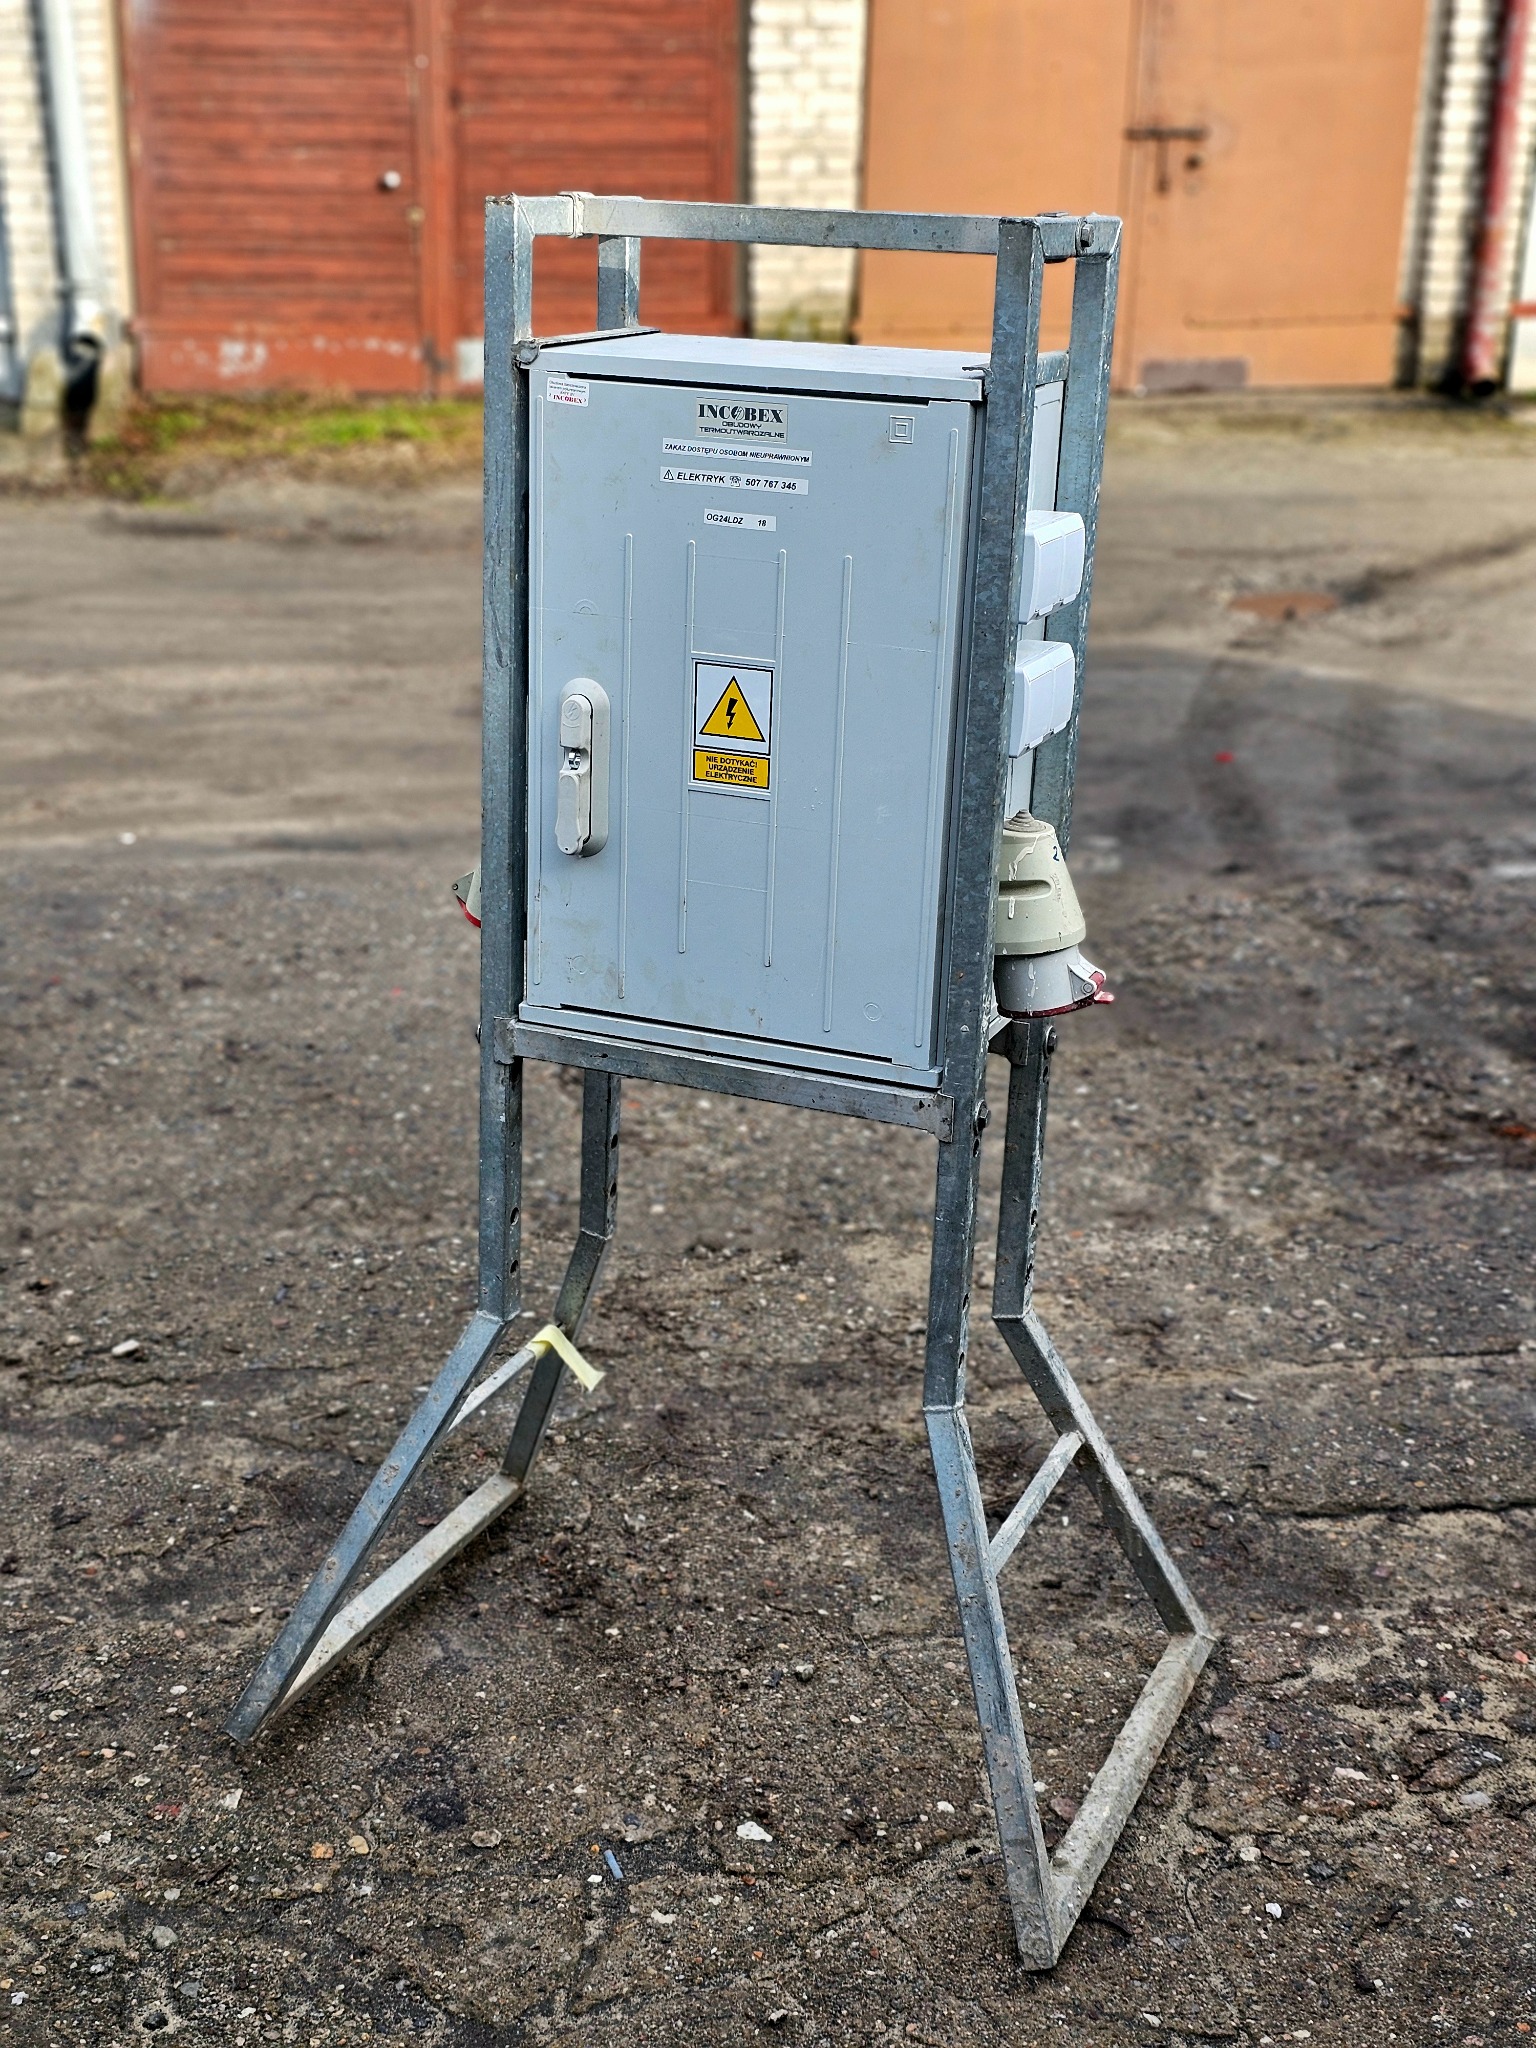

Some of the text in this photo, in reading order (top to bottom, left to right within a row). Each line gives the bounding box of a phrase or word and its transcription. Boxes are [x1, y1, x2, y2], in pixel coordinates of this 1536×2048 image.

[553, 394, 582, 404] INCOBEX
[698, 403, 784, 424] INCOBEX
[722, 421, 762, 429] OBUDOWY
[699, 426, 785, 438] TERMOUTWARDZALNE
[664, 443, 810, 463] ZAKAZ DOSTĘPU OSOBOM NIEUPRAWNIONYM
[676, 472, 797, 491] ELEKTRYK 507 767 345
[706, 513, 767, 527] OG24LDZ 18
[705, 755, 758, 768] NIE DOTYKAĆ!
[708, 763, 754, 775] URZĄDZENIE
[705, 770, 757, 783] ELEKTRYCZNE
